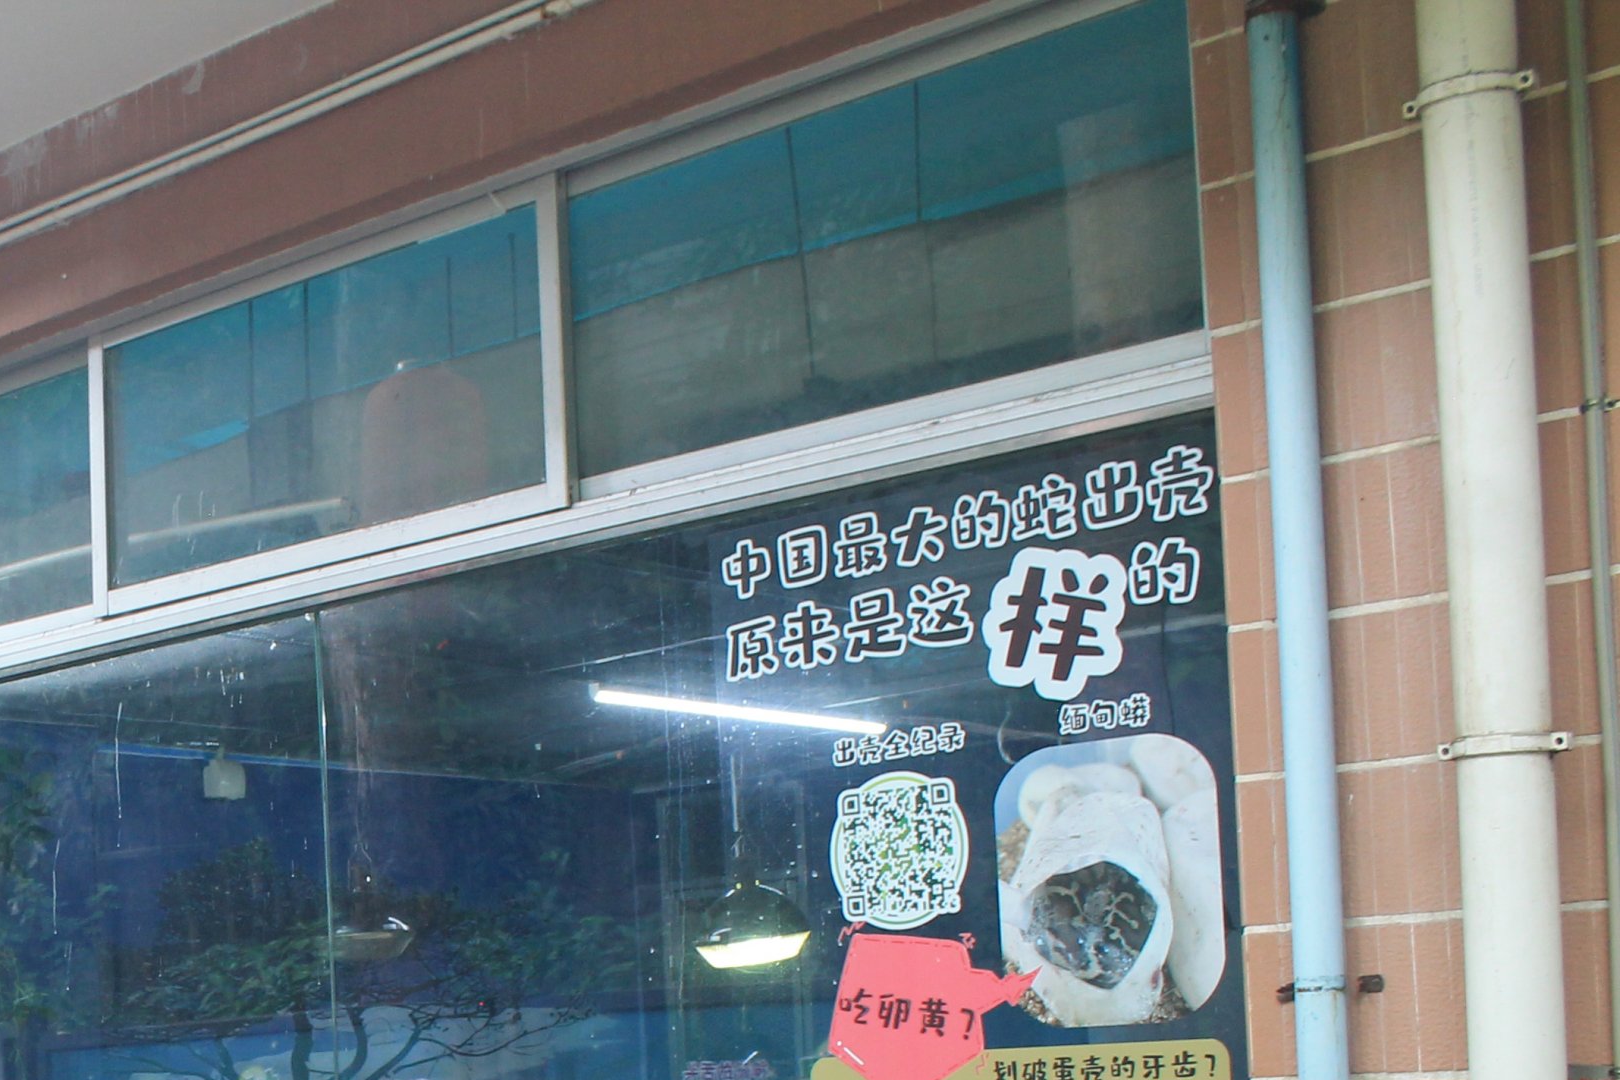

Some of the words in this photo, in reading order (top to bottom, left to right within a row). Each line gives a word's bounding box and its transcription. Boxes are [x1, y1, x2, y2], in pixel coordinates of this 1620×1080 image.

[723, 445, 1214, 600] 中国最大的蛇出壳
[725, 537, 1200, 700] 原来是这样的
[1058, 694, 1151, 736] 缅甸蟒
[832, 722, 965, 768] 出壳全纪录
[838, 988, 976, 1041] 吃卵黄？
